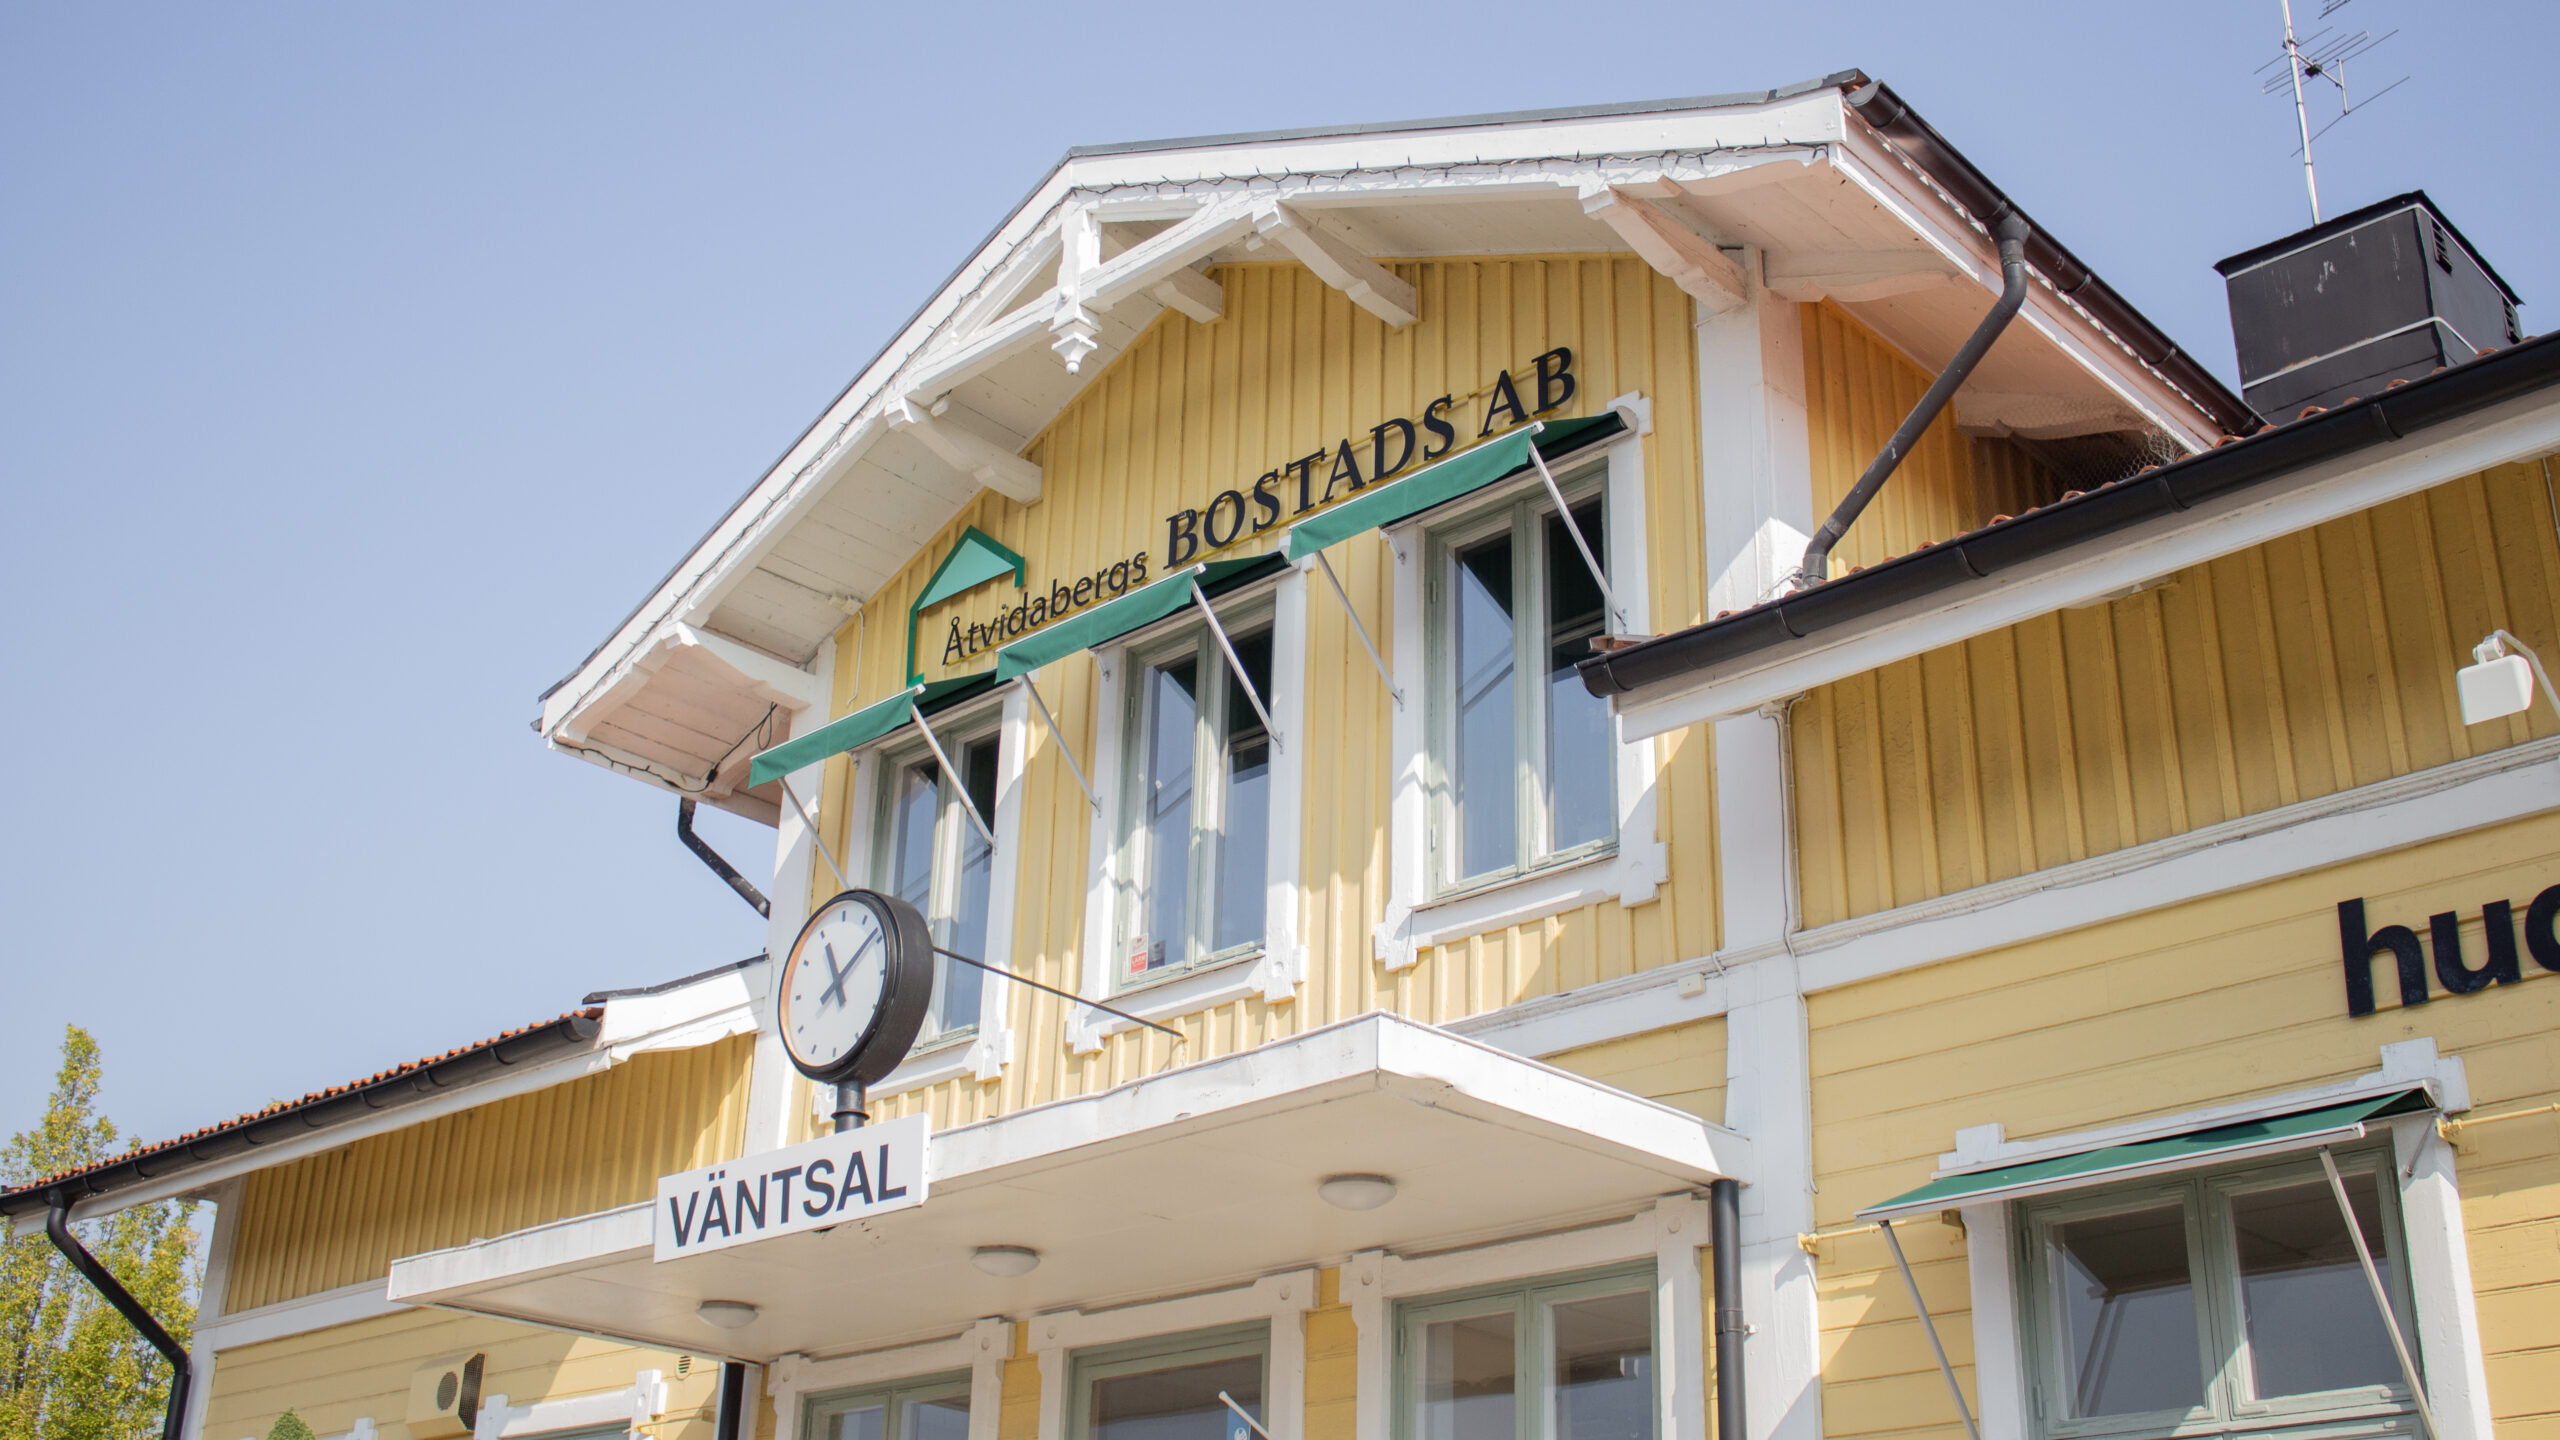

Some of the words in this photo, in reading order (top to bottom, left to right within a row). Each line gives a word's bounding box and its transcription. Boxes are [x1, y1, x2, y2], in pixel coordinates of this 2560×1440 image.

[942, 551, 1147, 666] Åtvidabergs
[1163, 394, 1455, 571] BOSTADS
[1477, 346, 1576, 440] AB
[670, 1143, 907, 1248] VÄNTSAL
